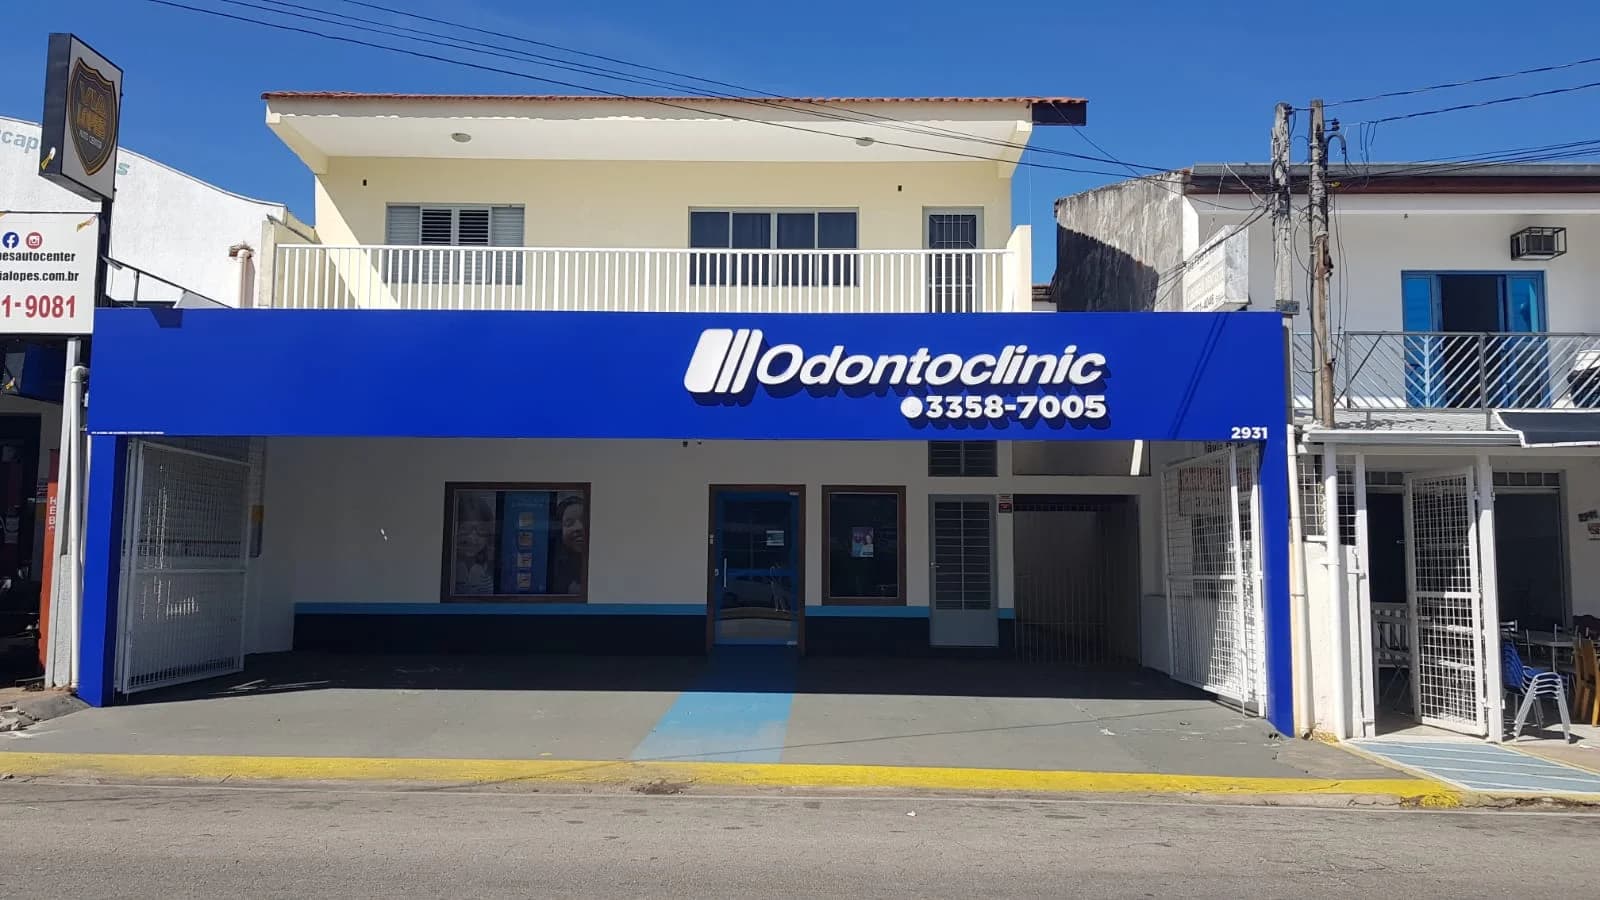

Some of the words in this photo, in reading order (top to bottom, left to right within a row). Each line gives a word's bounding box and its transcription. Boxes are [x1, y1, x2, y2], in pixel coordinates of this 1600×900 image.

[0, 130, 39, 153] cap
[756, 343, 1106, 386] Odontoclinic
[926, 395, 1106, 419] 3358-7005
[1231, 426, 1268, 440] 2931
